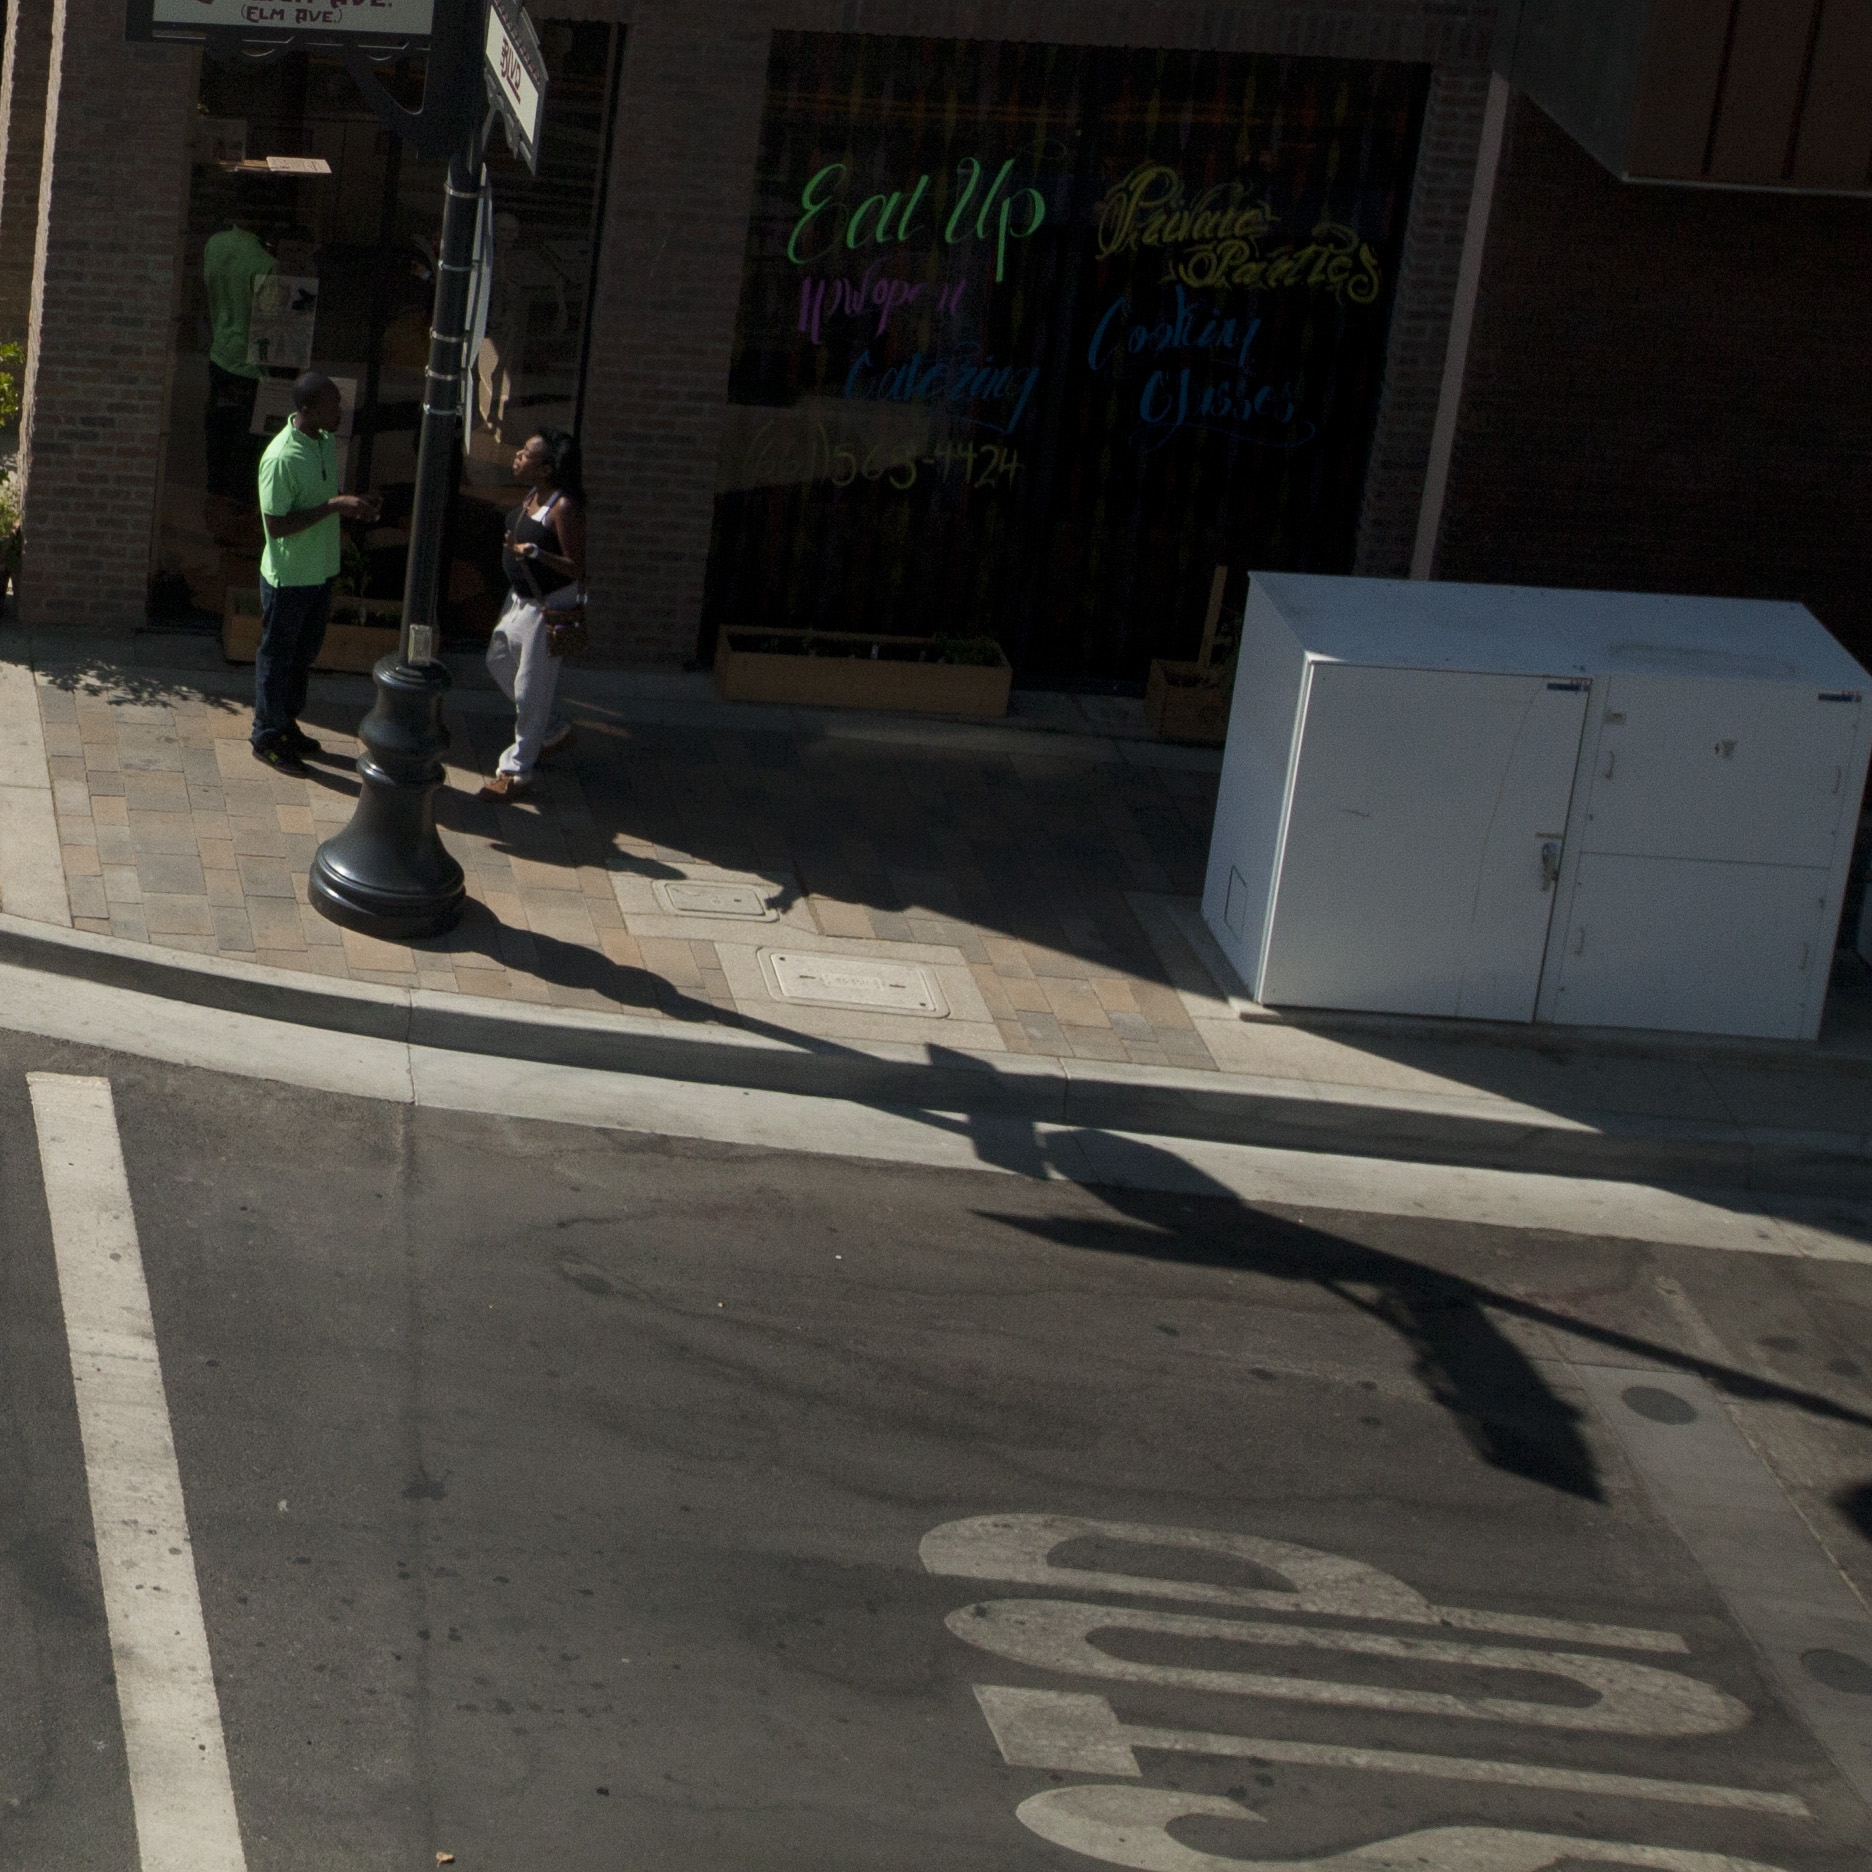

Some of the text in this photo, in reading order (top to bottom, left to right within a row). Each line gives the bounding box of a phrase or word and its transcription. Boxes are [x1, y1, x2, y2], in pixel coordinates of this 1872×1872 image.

[787, 156, 1047, 283] Eat Up
[1094, 165, 1271, 260] Private
[1177, 224, 1380, 304] Parties
[1088, 284, 1262, 371] Cooking
